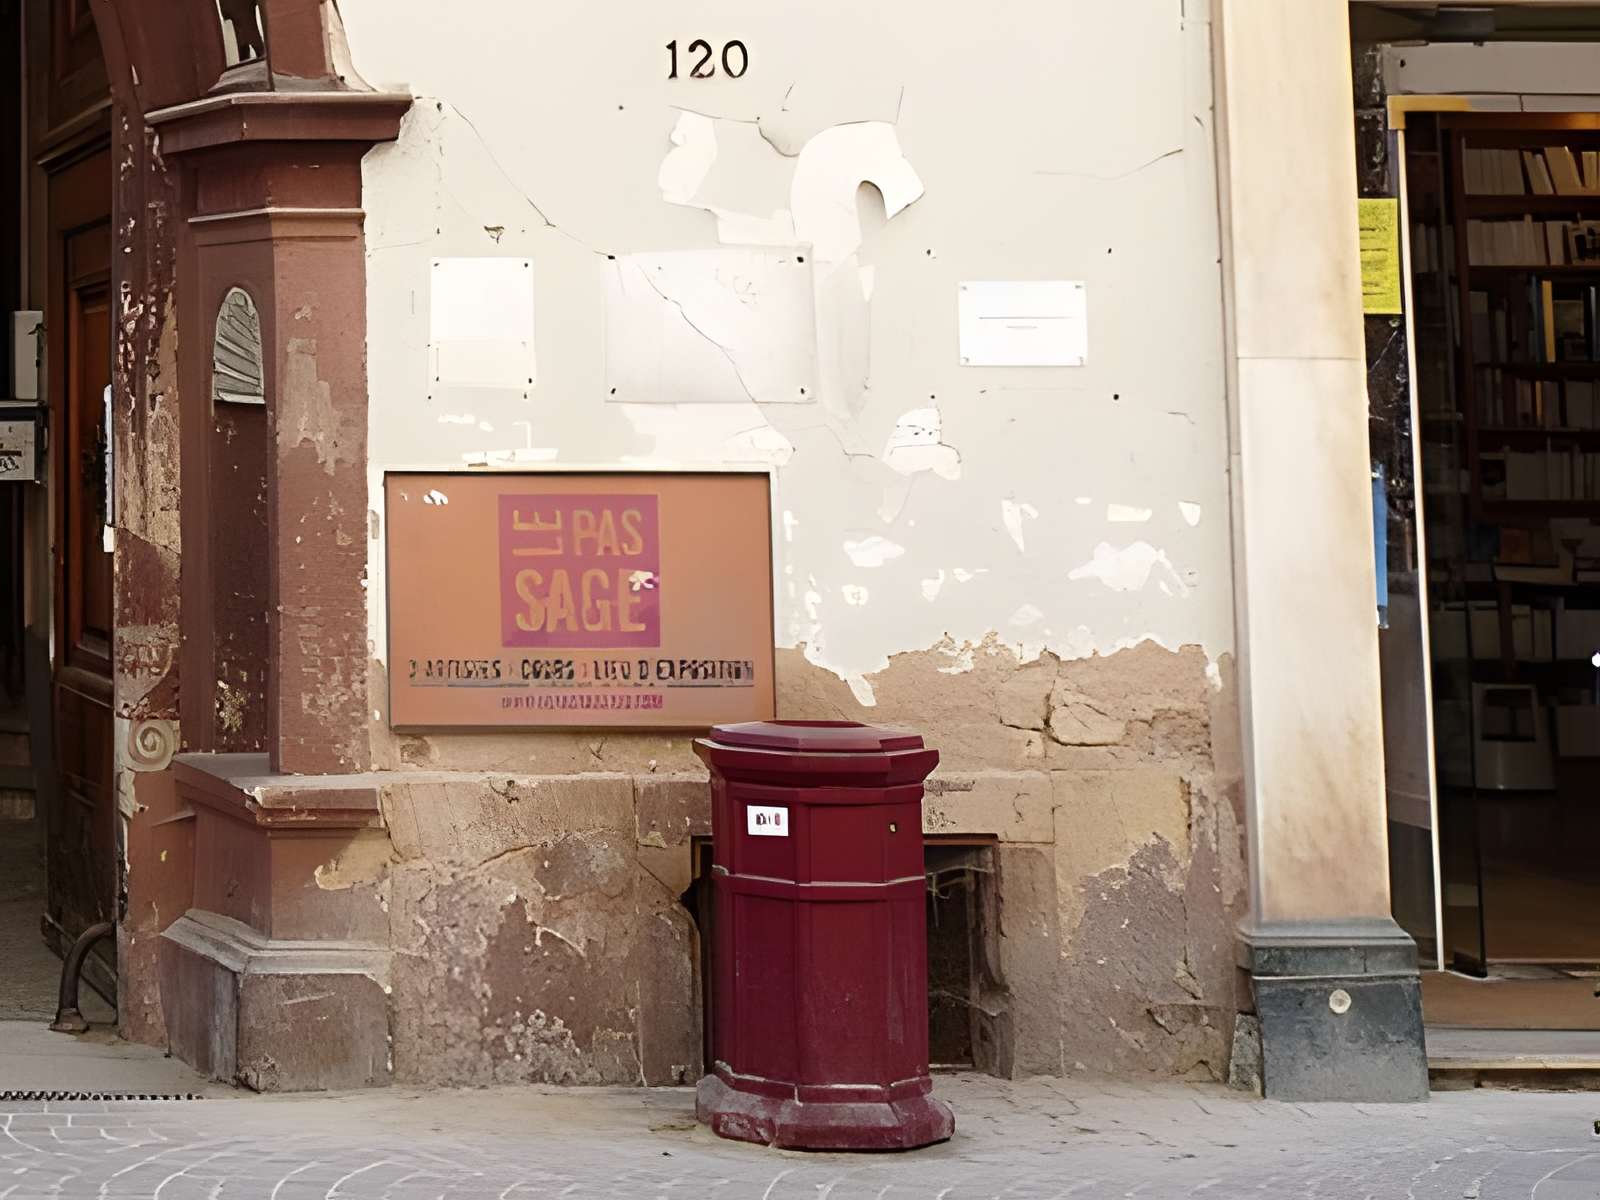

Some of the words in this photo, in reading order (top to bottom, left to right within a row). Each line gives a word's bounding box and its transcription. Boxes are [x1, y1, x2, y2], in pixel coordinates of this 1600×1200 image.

[666, 39, 749, 80] 120
[512, 509, 563, 556] LE
[573, 509, 644, 557] PAS
[515, 568, 647, 633] SAGE
